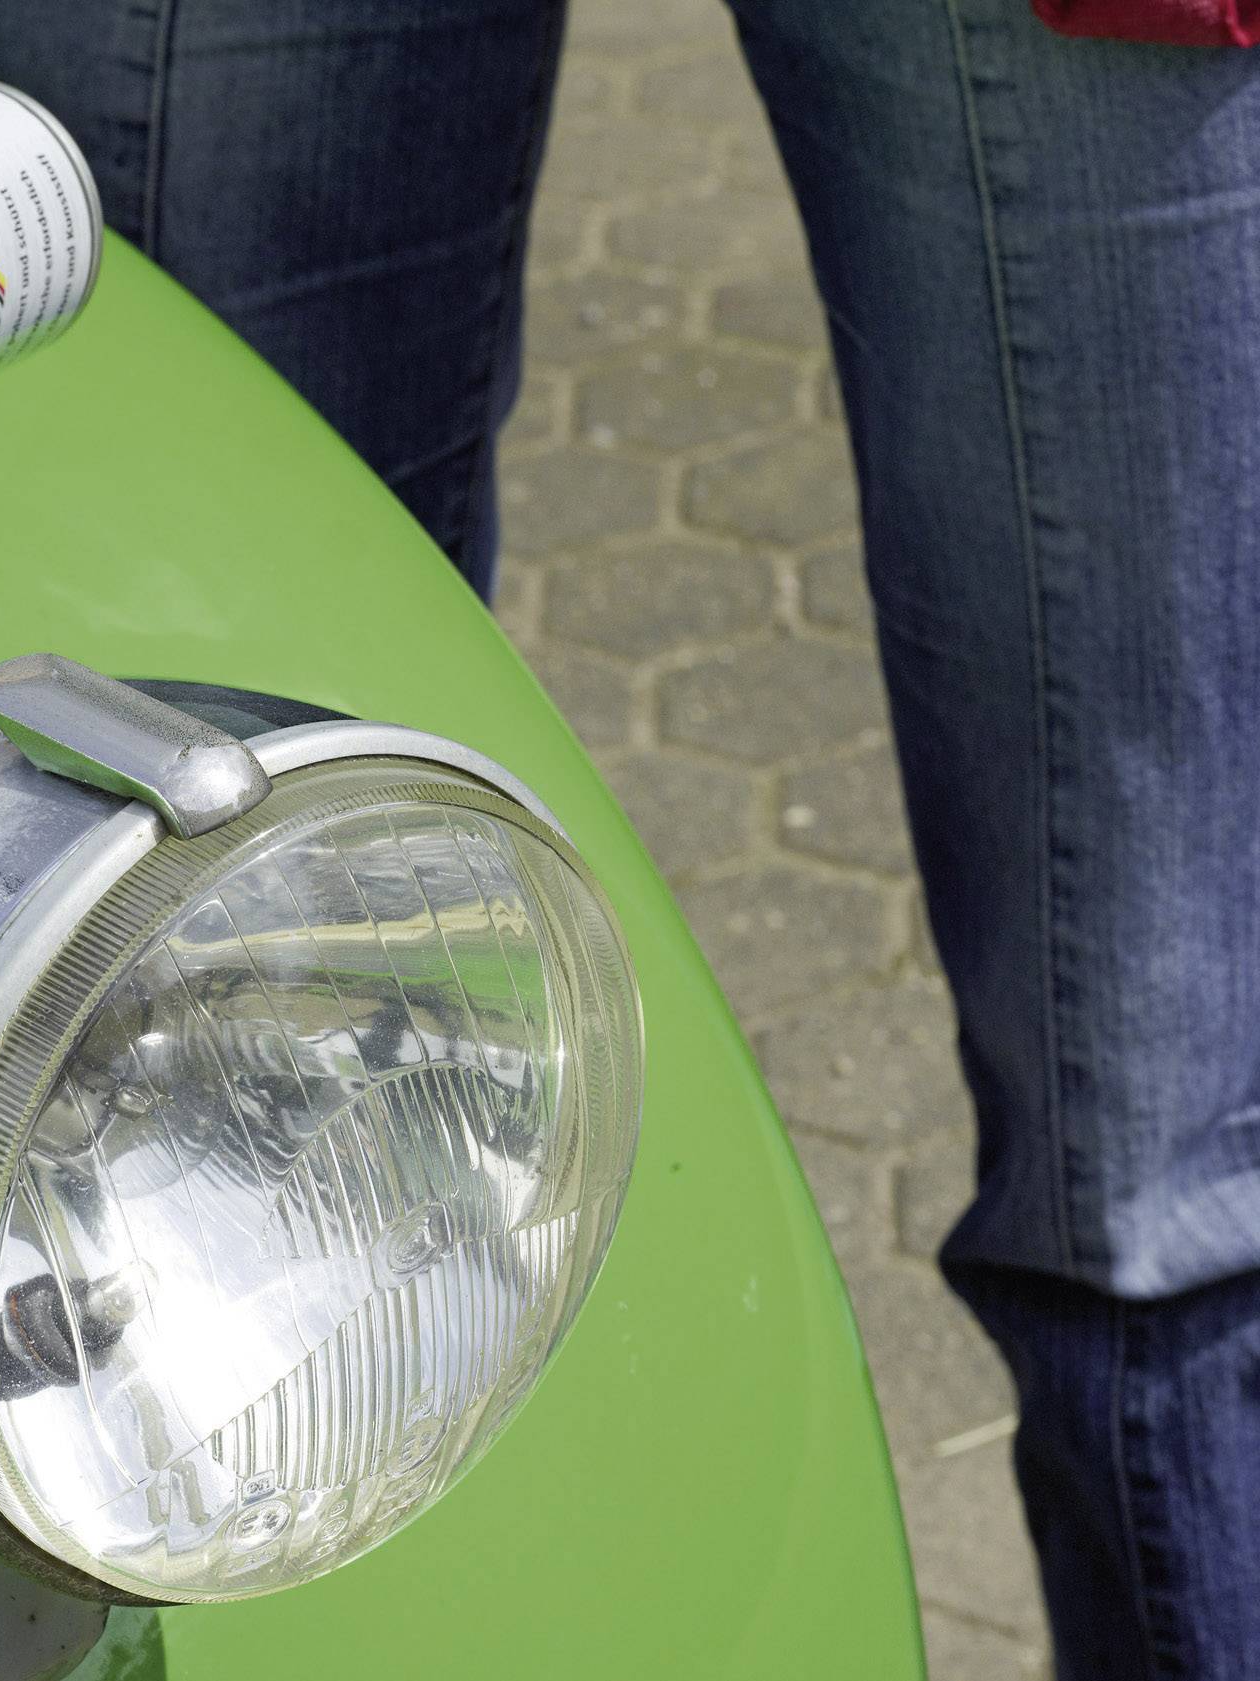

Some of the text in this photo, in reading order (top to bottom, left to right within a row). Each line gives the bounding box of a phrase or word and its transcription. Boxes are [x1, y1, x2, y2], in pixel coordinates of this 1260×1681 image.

[0, 188, 28, 249] schützt
[20, 170, 52, 270] erforderlich
[38, 154, 74, 239] Kunststoff
[19, 255, 28, 288] und
[67, 246, 75, 278] und
